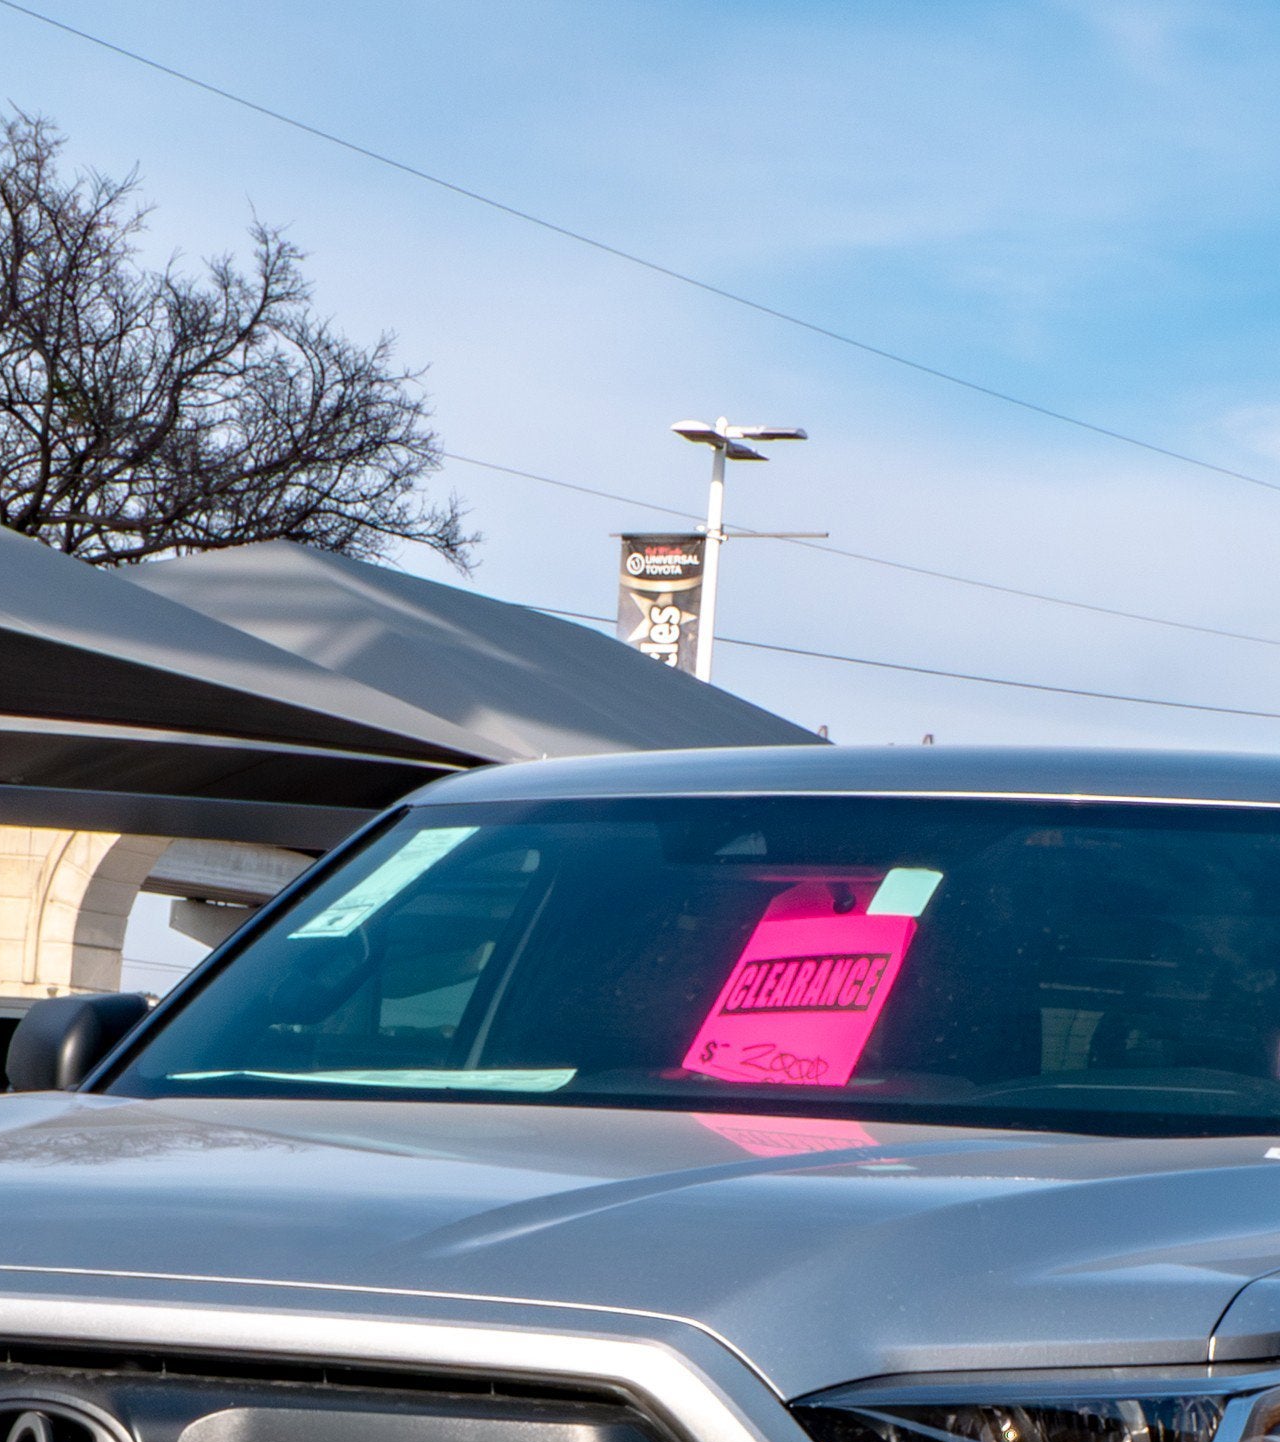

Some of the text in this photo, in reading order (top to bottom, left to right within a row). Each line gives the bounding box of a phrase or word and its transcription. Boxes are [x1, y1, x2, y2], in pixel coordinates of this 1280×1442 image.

[645, 555, 700, 565] UNIVERSAL
[646, 565, 682, 575] TOYOTA
[723, 955, 888, 1012] CLEARANCE
